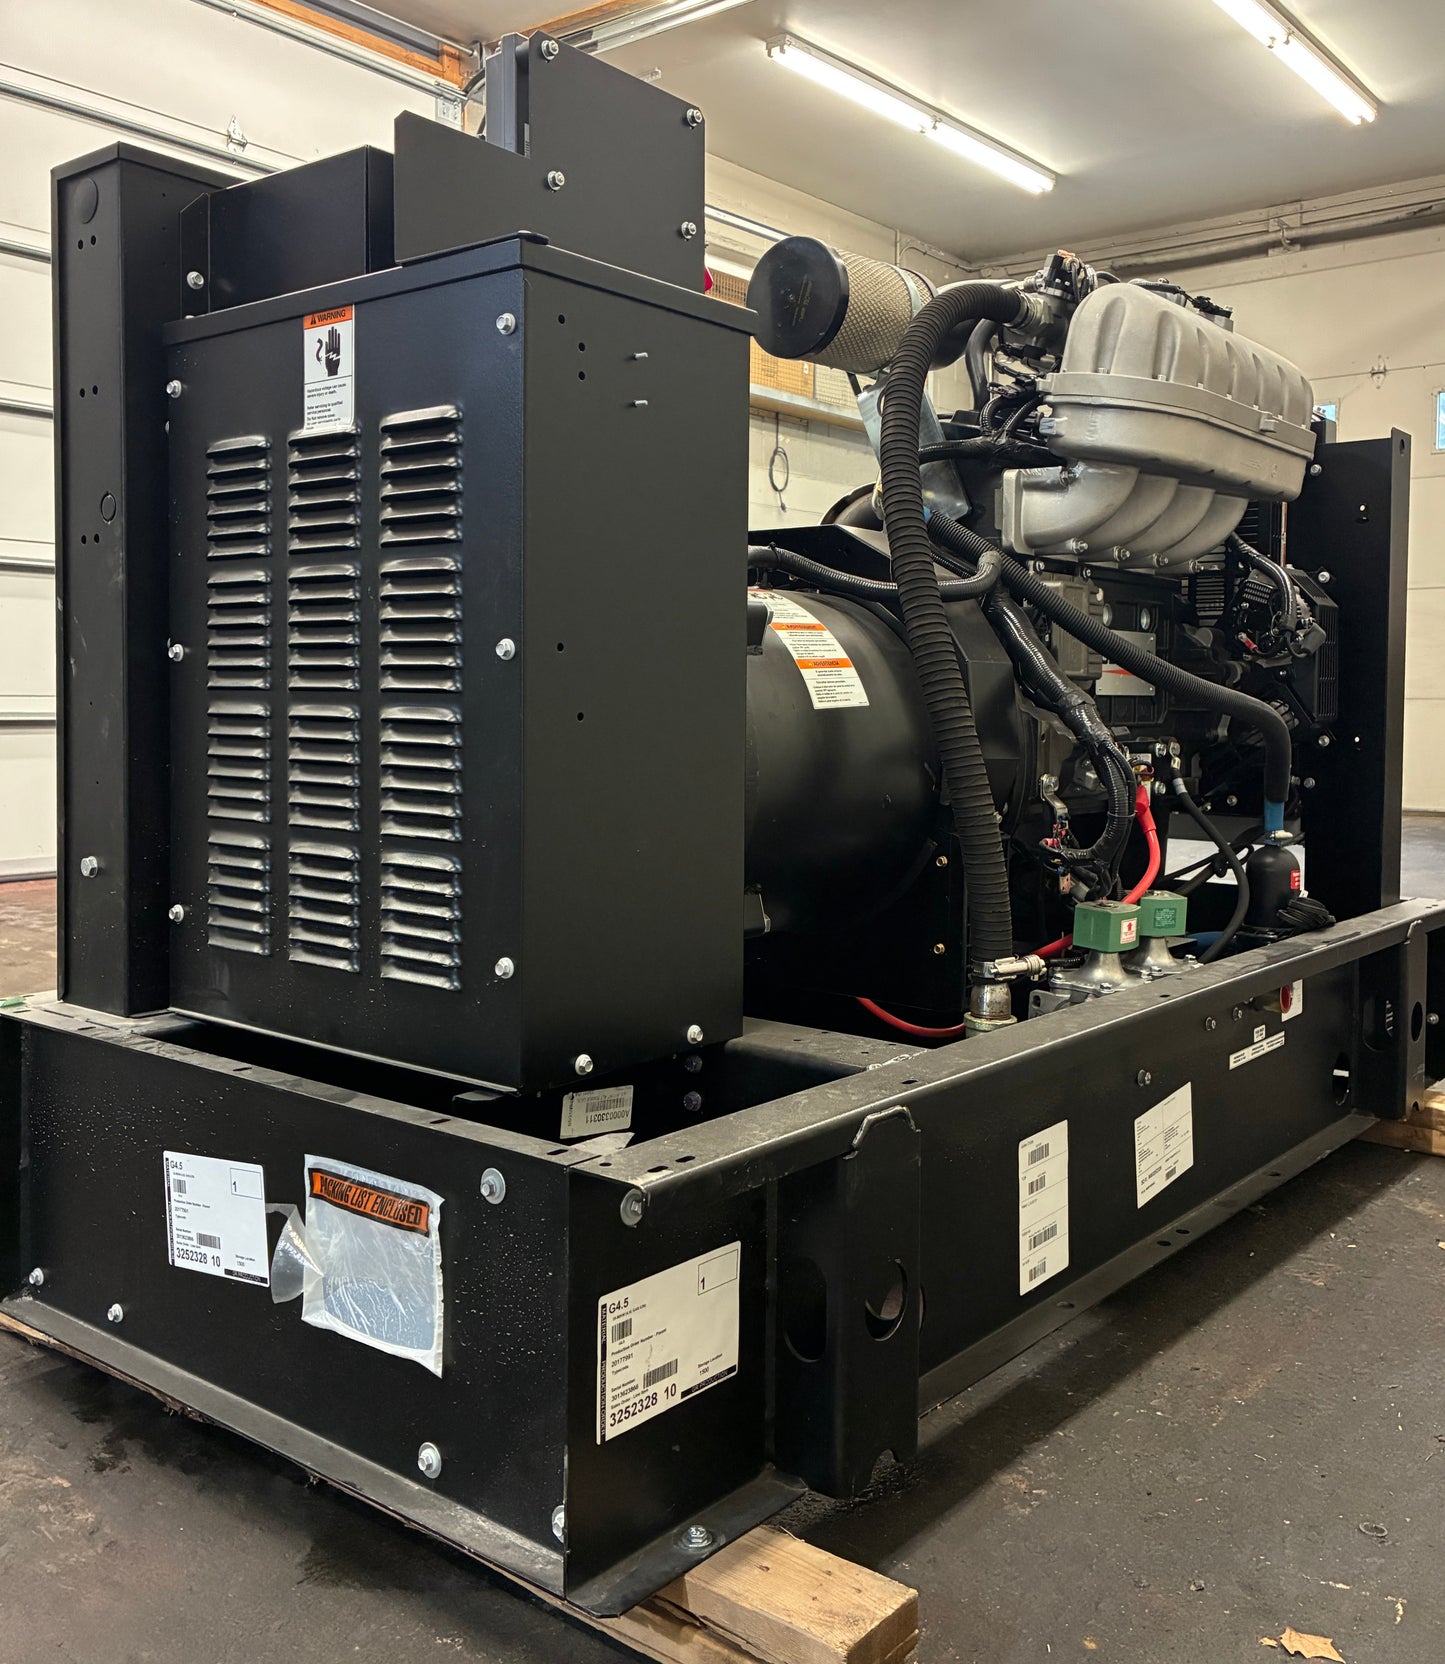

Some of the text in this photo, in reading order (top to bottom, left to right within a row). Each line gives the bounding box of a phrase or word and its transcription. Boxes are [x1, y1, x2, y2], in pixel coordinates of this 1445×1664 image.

[317, 309, 346, 322] WARNING
[170, 1160, 183, 1170] G4.5
[232, 1181, 237, 1192] 1
[319, 1175, 422, 1225] PACKING LIST ENCLOSED
[176, 1247, 221, 1267] 3252328 10
[700, 1276, 706, 1290] 1
[608, 1297, 629, 1313] G4.5
[609, 1383, 677, 1427] 3252328 10
